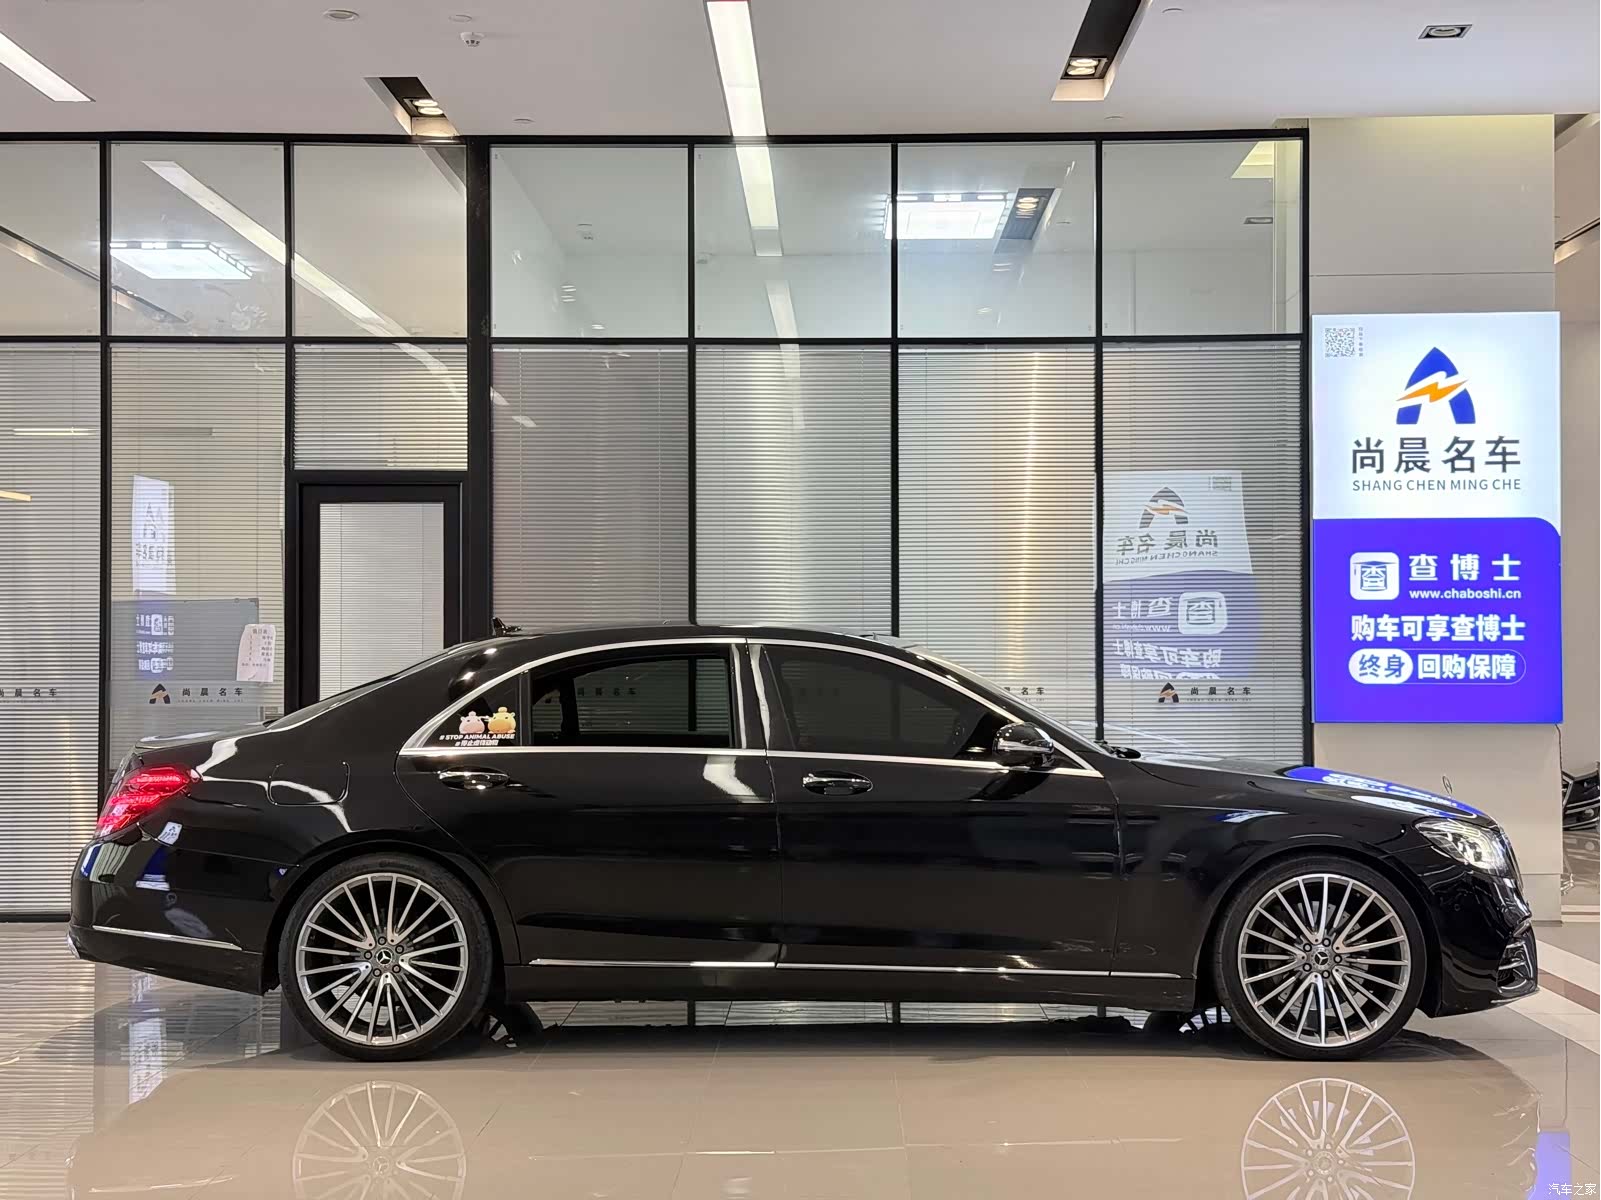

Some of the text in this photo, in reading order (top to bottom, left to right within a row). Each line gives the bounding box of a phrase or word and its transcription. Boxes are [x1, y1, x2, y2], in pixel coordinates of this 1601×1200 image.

[1352, 435, 1521, 474] 尚晨名车
[1352, 479, 1521, 491] SHANG CHEN MING CHE
[1408, 553, 1521, 581] 查博士
[1409, 588, 1522, 599] www.chaboshi.cn
[1351, 614, 1526, 642] 购车可享查博士
[1358, 653, 1517, 680] 终身 回购保障
